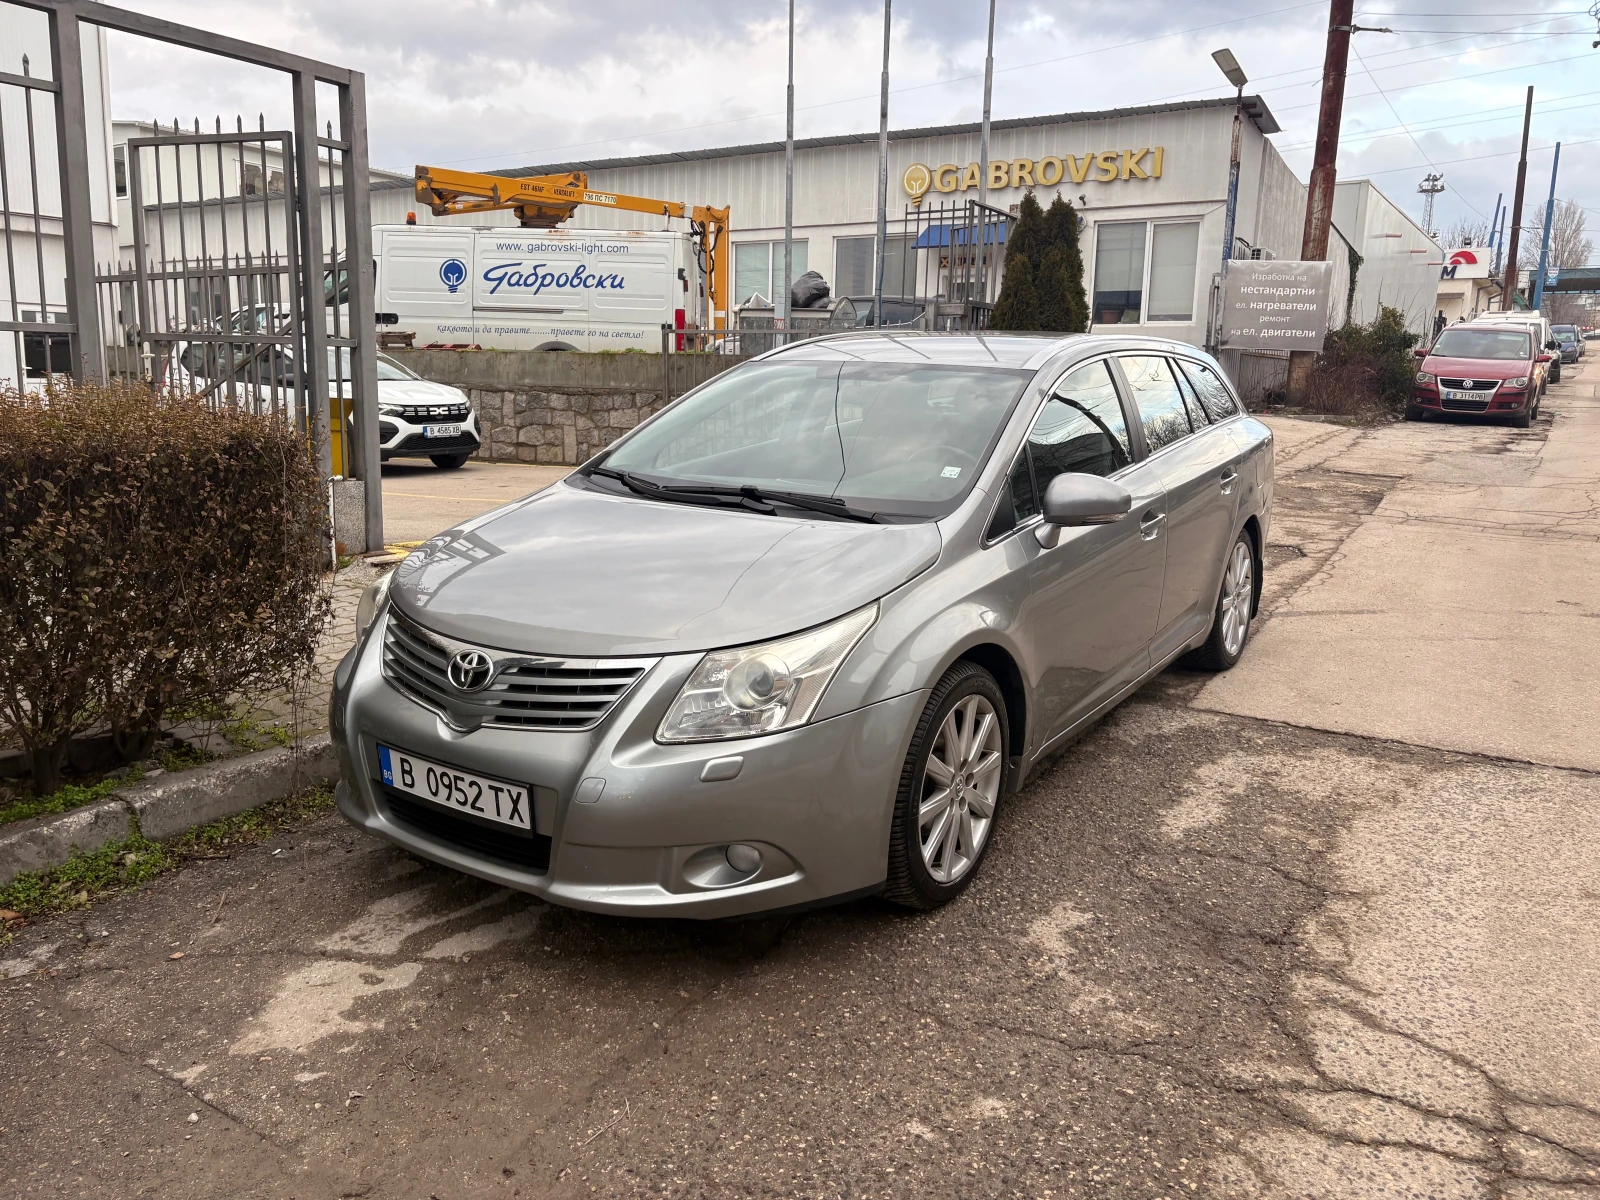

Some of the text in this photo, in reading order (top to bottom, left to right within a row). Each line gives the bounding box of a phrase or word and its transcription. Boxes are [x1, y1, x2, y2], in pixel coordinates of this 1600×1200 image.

[933, 146, 1164, 193] GABROVSKI
[520, 183, 530, 191] EST
[483, 262, 625, 295] Габровски
[1252, 272, 1295, 281] Изработка
[1240, 286, 1316, 297] нестандартни
[1250, 301, 1317, 311] нагреватели
[1259, 315, 1290, 323] ремонт
[437, 325, 472, 334] каквото
[482, 324, 492, 333] да
[612, 330, 645, 339] светло!
[1243, 327, 1258, 336] ел.
[1260, 328, 1316, 338] двигатели
[399, 757, 415, 789] B
